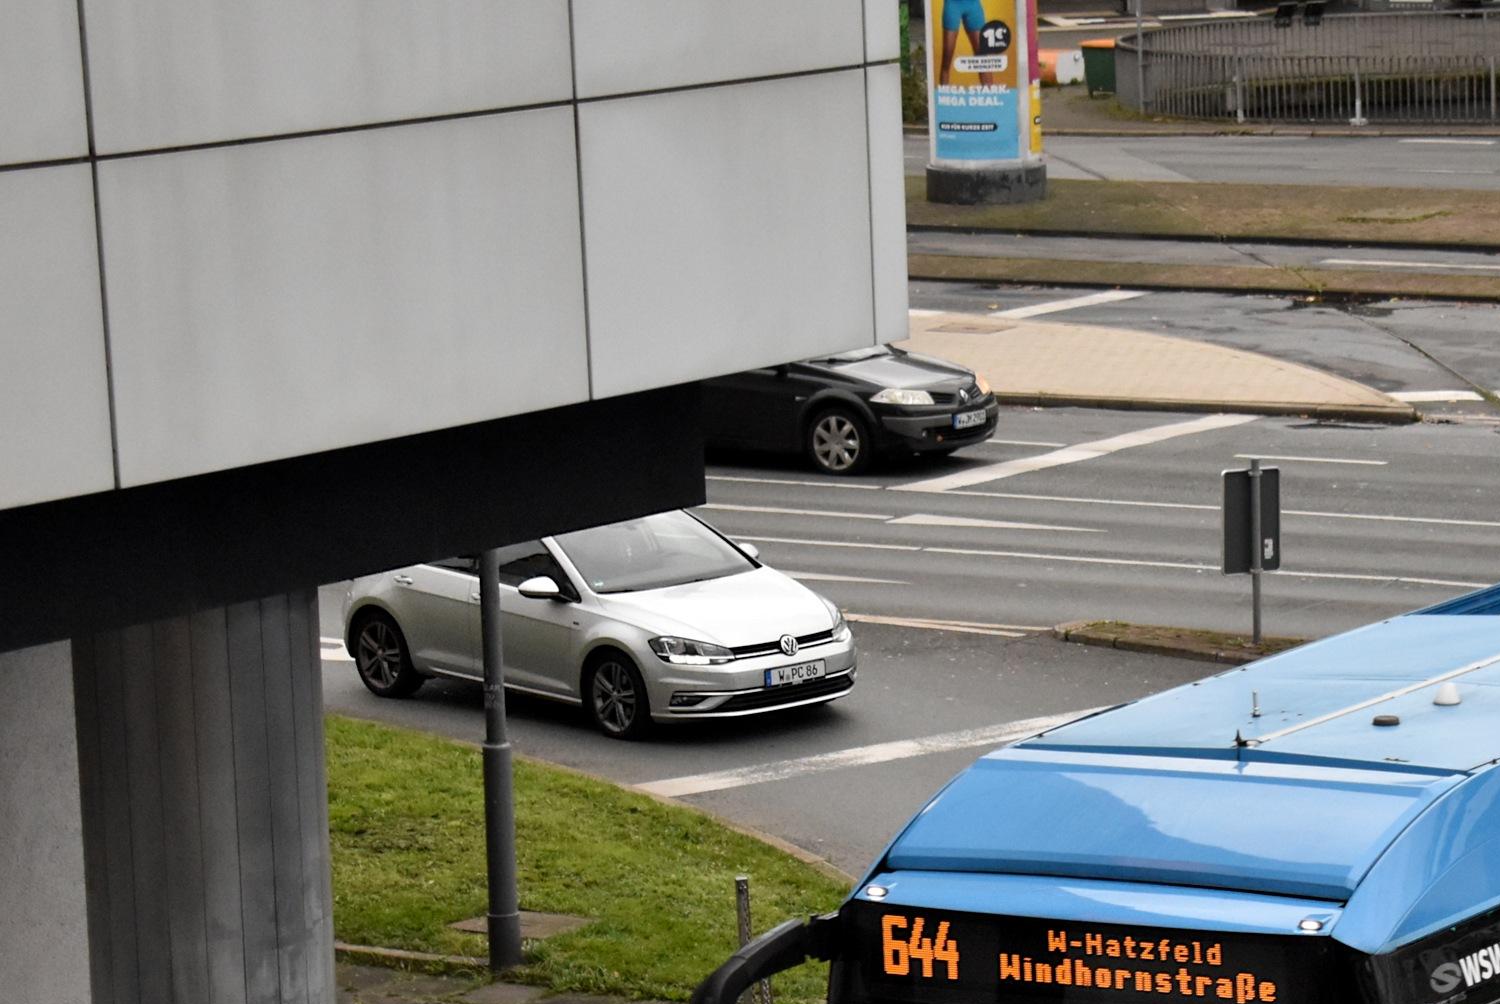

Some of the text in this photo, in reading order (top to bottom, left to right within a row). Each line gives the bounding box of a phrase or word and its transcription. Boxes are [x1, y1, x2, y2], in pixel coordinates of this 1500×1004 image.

[937, 84, 1010, 95] MEGA STARK.
[937, 95, 1004, 106] MEGA DEAL.
[791, 667, 804, 679] PC
[806, 664, 818, 676] 86
[881, 914, 959, 980] 644
[1047, 929, 1222, 966] W-Hatzfeld
[999, 953, 1278, 1004] Windhornstraße
